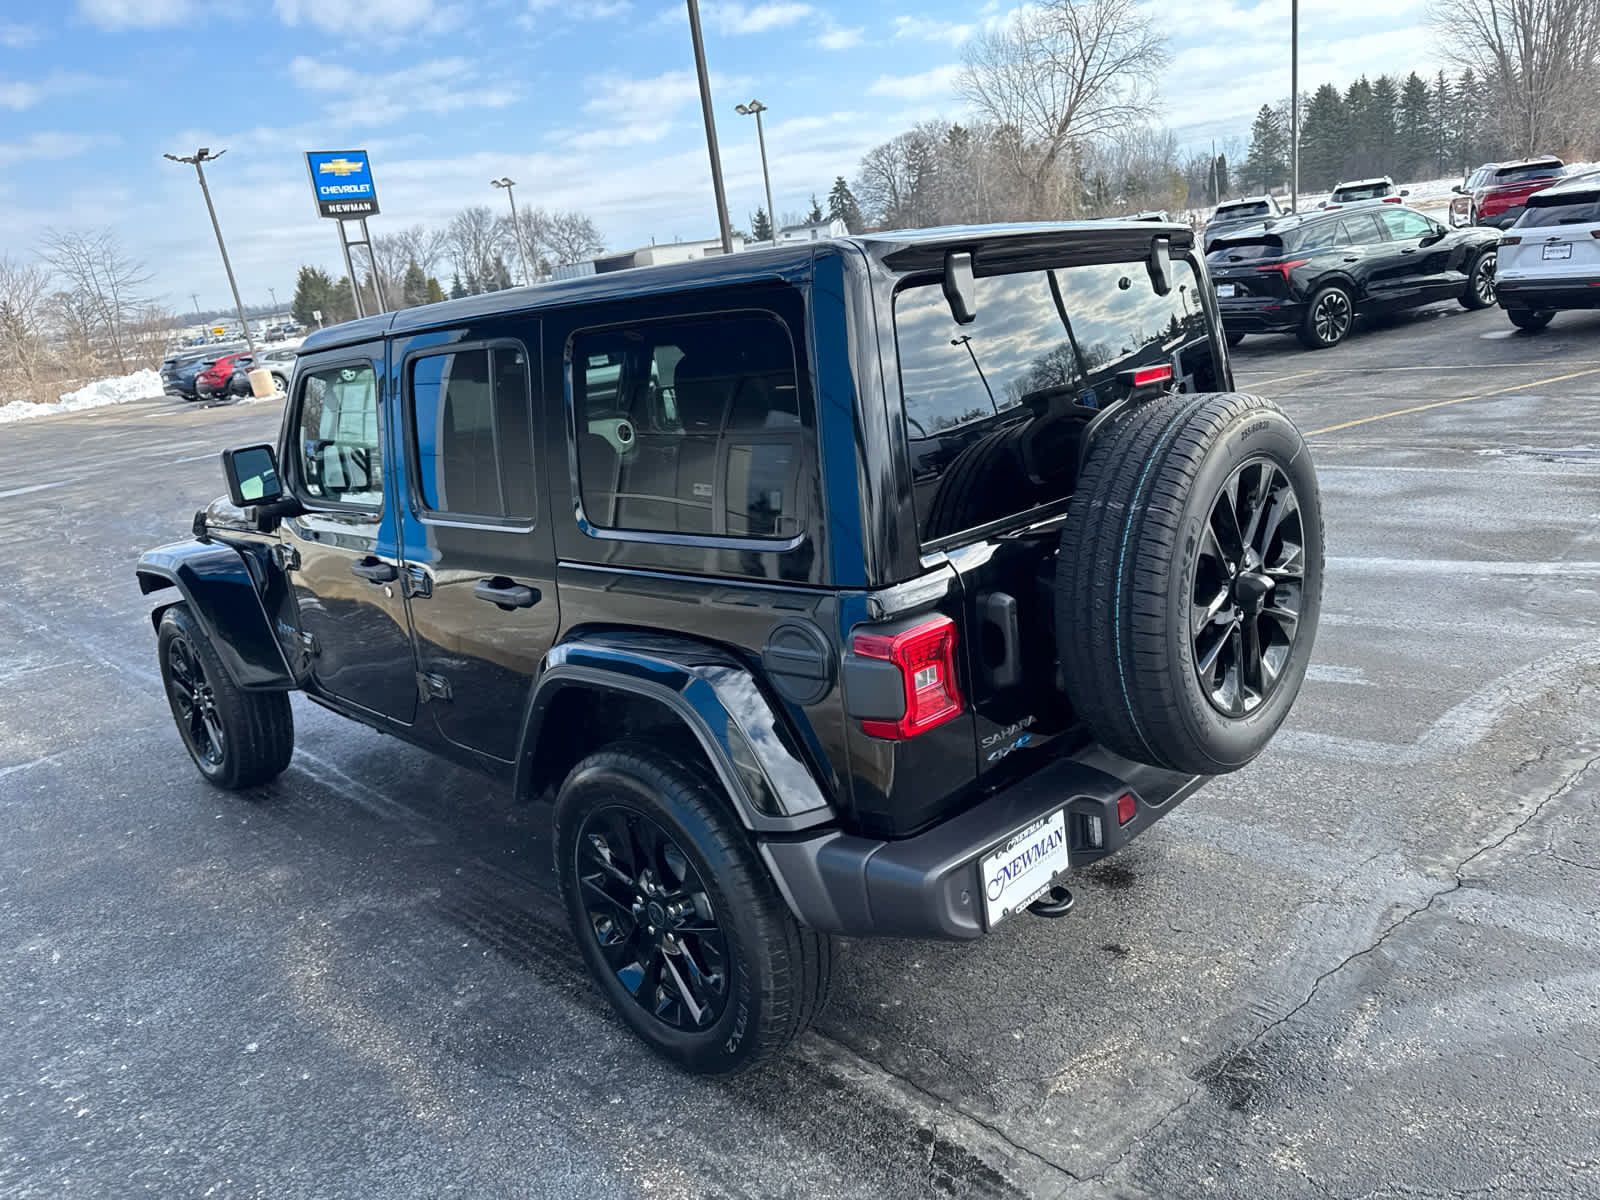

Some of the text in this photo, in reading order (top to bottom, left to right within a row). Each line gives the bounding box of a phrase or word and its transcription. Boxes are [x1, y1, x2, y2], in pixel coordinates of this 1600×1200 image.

[320, 184, 370, 194] CHEVROLET
[328, 203, 371, 213] NEWMAN
[981, 715, 1037, 748] SAHARA
[987, 826, 1063, 901] NEWMAN
